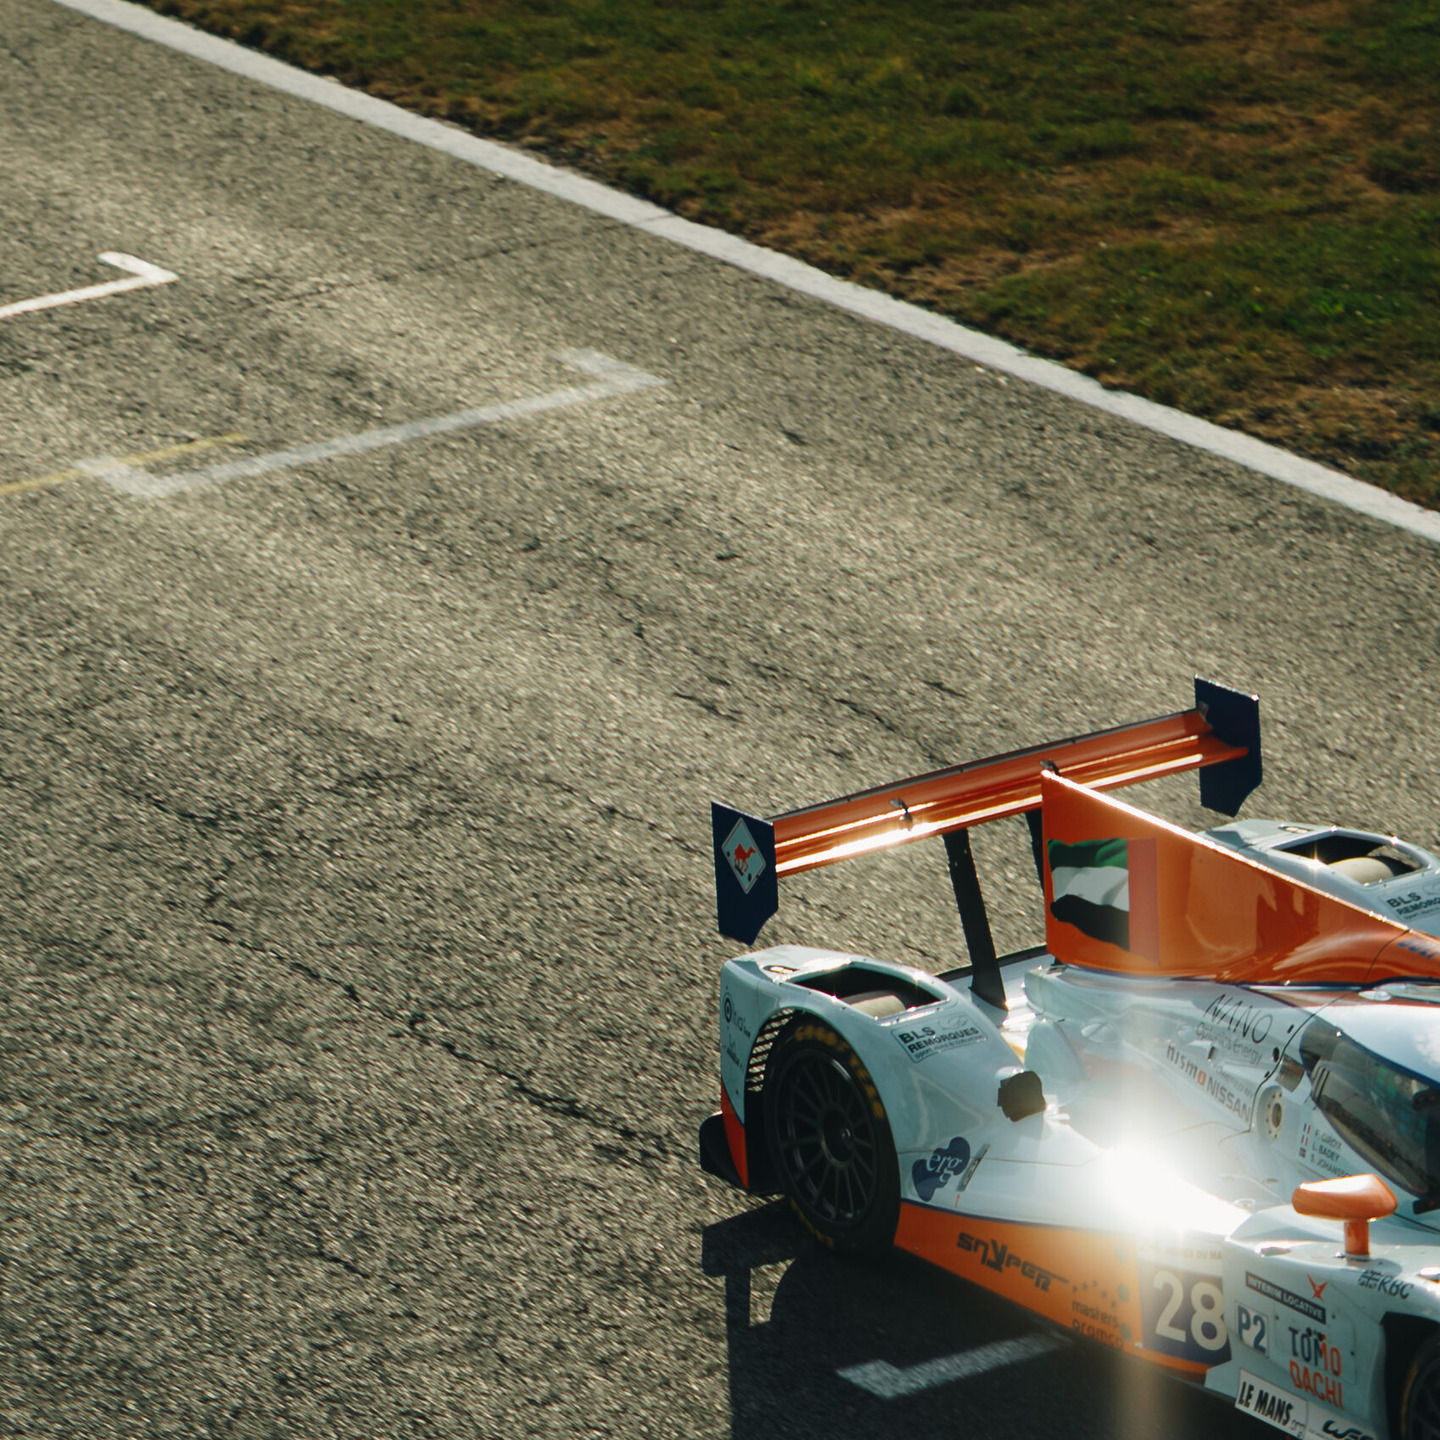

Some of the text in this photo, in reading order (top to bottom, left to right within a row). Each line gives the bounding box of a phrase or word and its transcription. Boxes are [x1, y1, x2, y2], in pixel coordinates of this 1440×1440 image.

[1386, 892, 1422, 908] BLS
[898, 1026, 936, 1044] BLS
[1203, 993, 1272, 1043] NANO
[907, 1027, 979, 1053] REMORQUES
[1207, 1076, 1250, 1124] NISSAN
[926, 1153, 962, 1183] erg
[1152, 1269, 1228, 1351] 28
[1282, 1291, 1324, 1321] LOCATIVE
[1237, 1304, 1267, 1354] P2
[1288, 1325, 1342, 1377] TOMO
[1239, 1381, 1254, 1408] LE
[1289, 1359, 1345, 1410] DACHI
